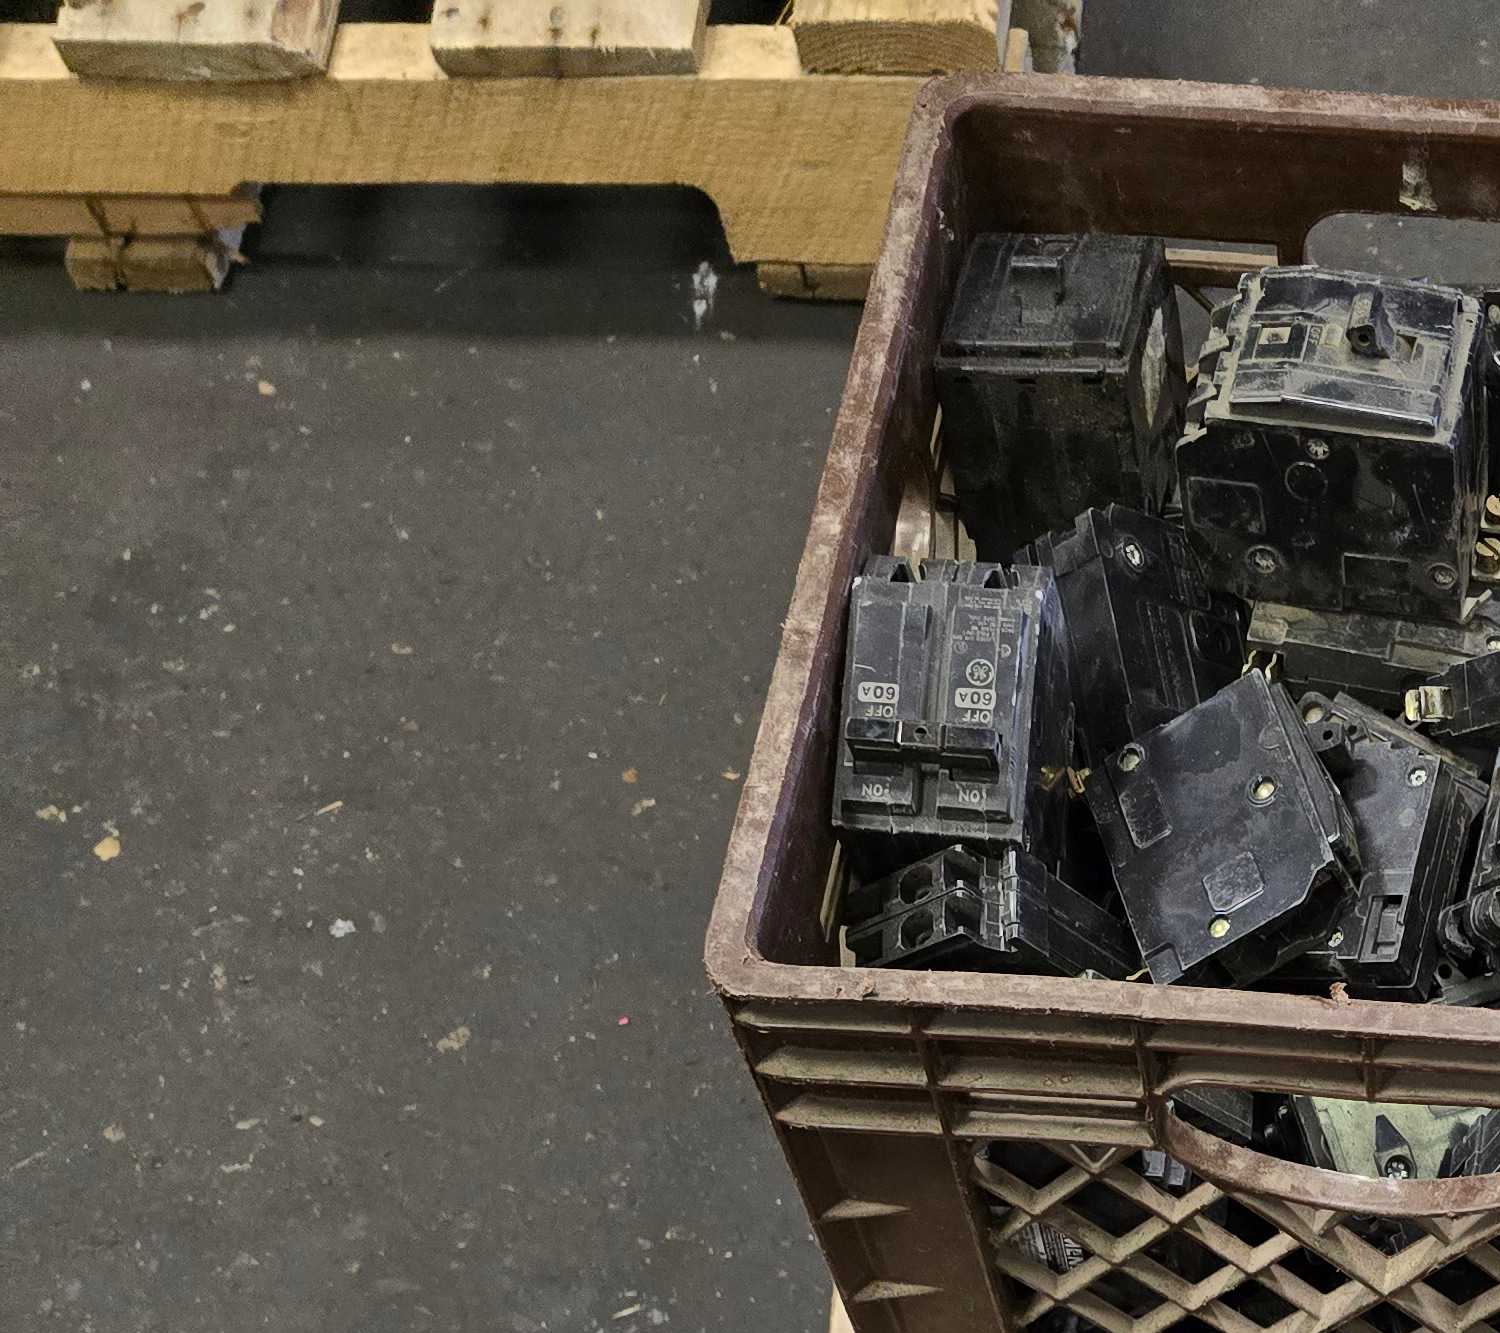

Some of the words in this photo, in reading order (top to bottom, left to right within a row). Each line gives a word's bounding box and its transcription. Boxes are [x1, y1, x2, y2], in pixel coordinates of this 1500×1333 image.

[861, 685, 896, 699] 60A
[958, 691, 992, 705] 60A
[864, 705, 893, 718] OFF
[961, 710, 991, 723] OFF
[862, 783, 883, 796] ON
[958, 790, 982, 802] ON
